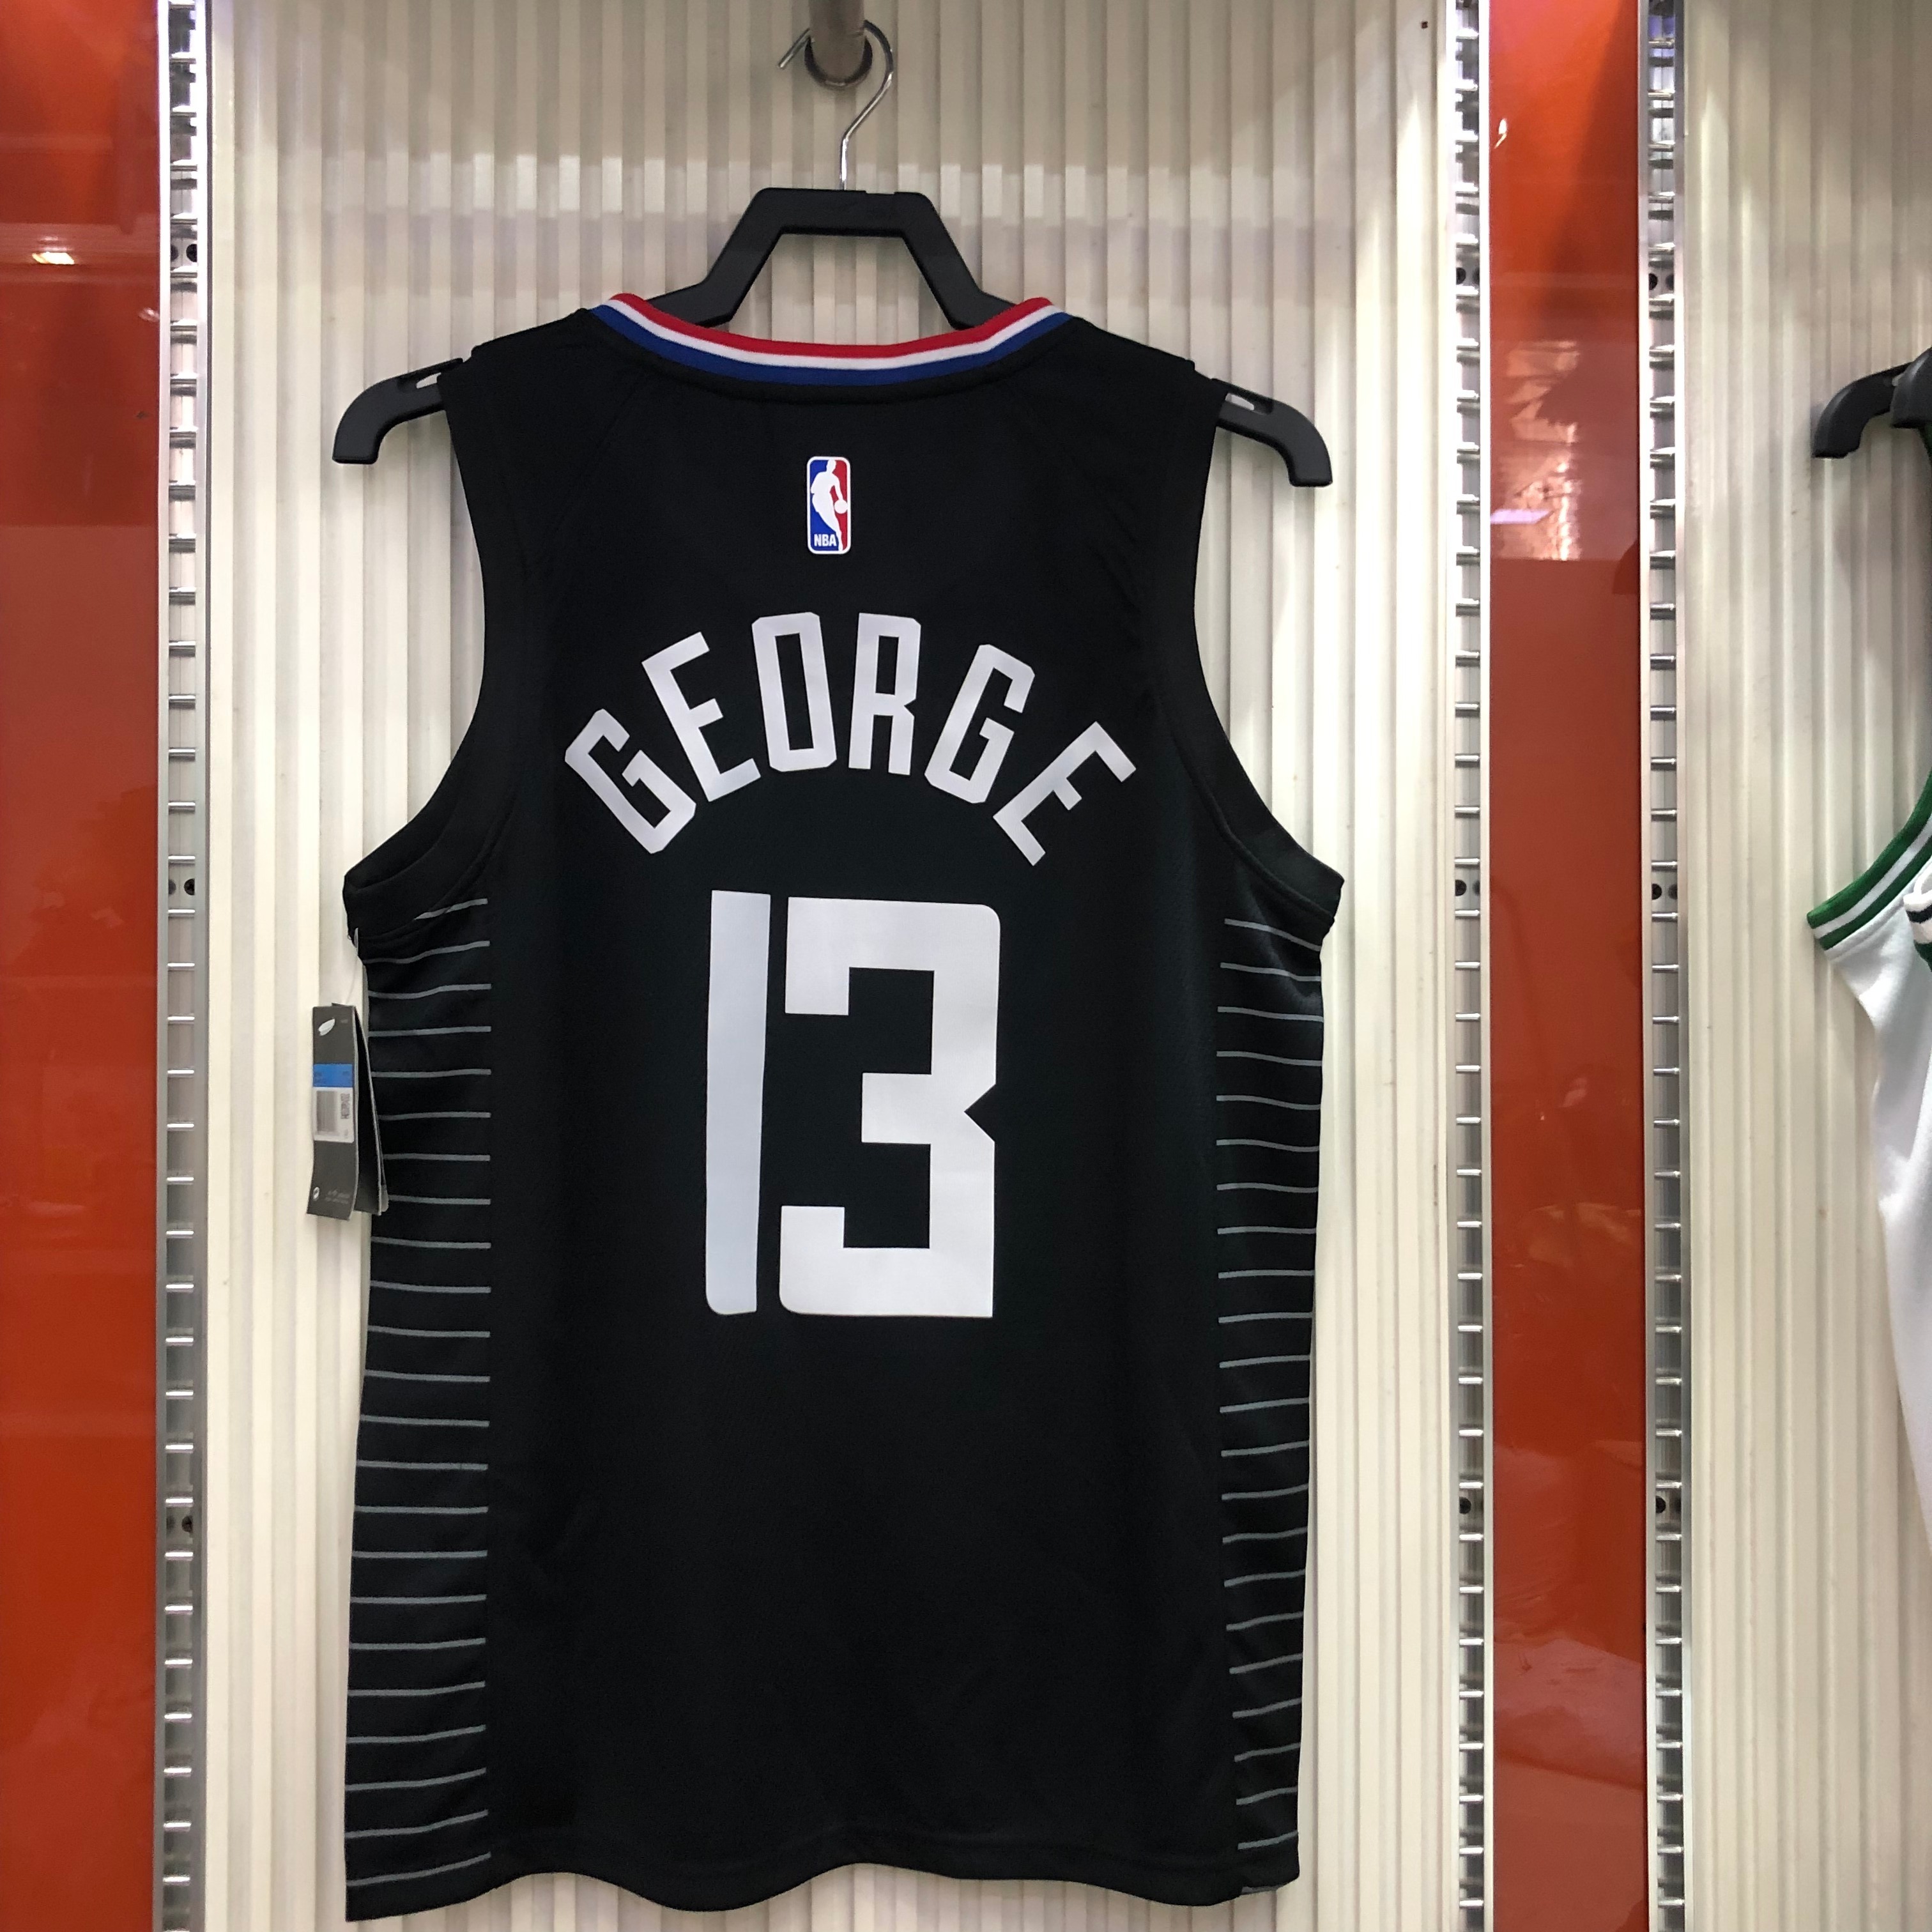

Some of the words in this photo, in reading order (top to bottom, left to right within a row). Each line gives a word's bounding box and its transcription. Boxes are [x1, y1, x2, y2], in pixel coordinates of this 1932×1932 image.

[813, 533, 837, 547] NBA
[565, 612, 1136, 866] GEORGE
[706, 890, 1000, 1317] 13
